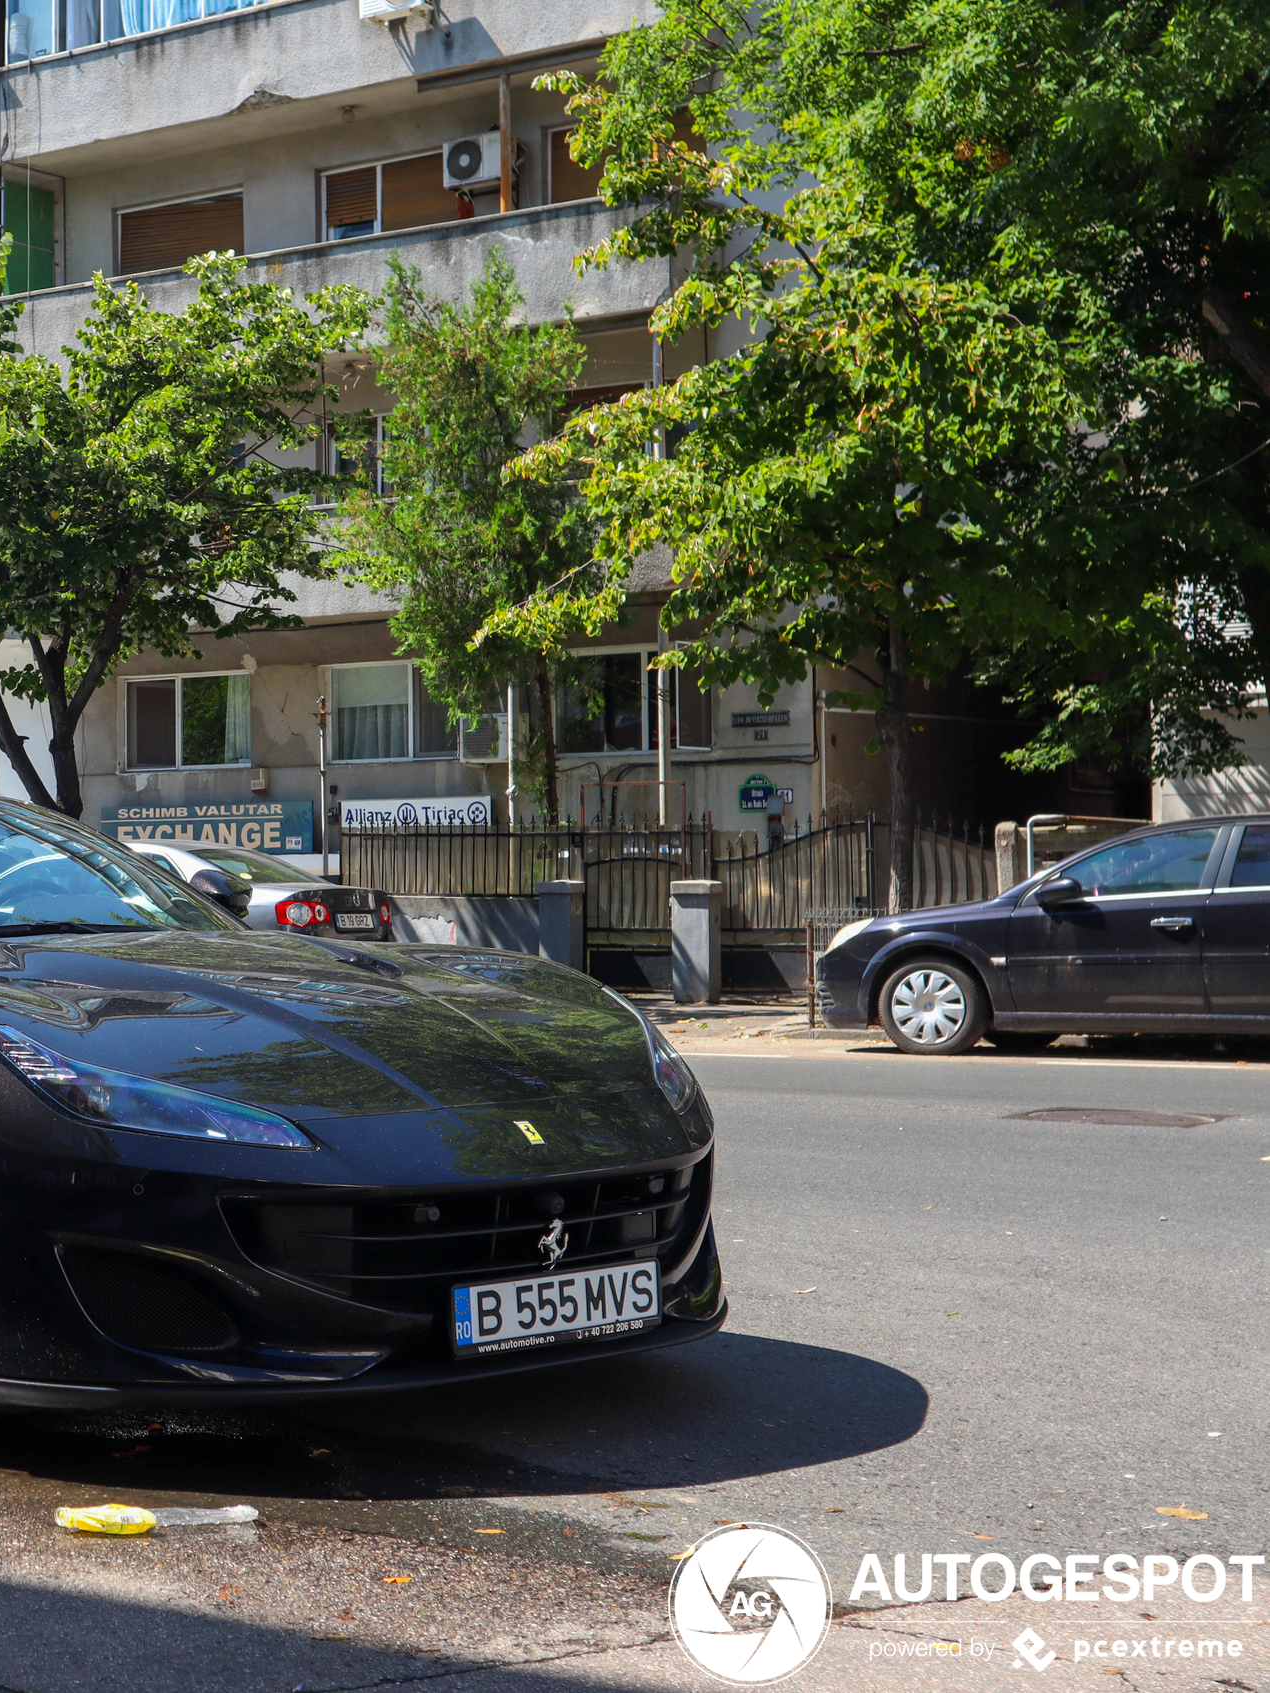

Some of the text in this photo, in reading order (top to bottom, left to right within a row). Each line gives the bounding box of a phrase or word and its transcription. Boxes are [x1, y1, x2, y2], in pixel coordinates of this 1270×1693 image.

[751, 788, 763, 797] Strada
[753, 799, 762, 808] Radu
[117, 804, 283, 819] SCHIMB VALUTAR
[345, 808, 392, 823] Allianz
[117, 821, 281, 850] EXCHANGE
[340, 915, 346, 926] B
[347, 915, 354, 926] 19
[355, 915, 370, 926] GRZ
[477, 1269, 653, 1337] B 555 MVS
[456, 1321, 471, 1341] RO
[478, 1335, 555, 1354] www.automotive.ro
[591, 1326, 600, 1336] 40
[601, 1324, 615, 1335] 722
[616, 1321, 629, 1332] 206
[630, 1319, 644, 1330] 580
